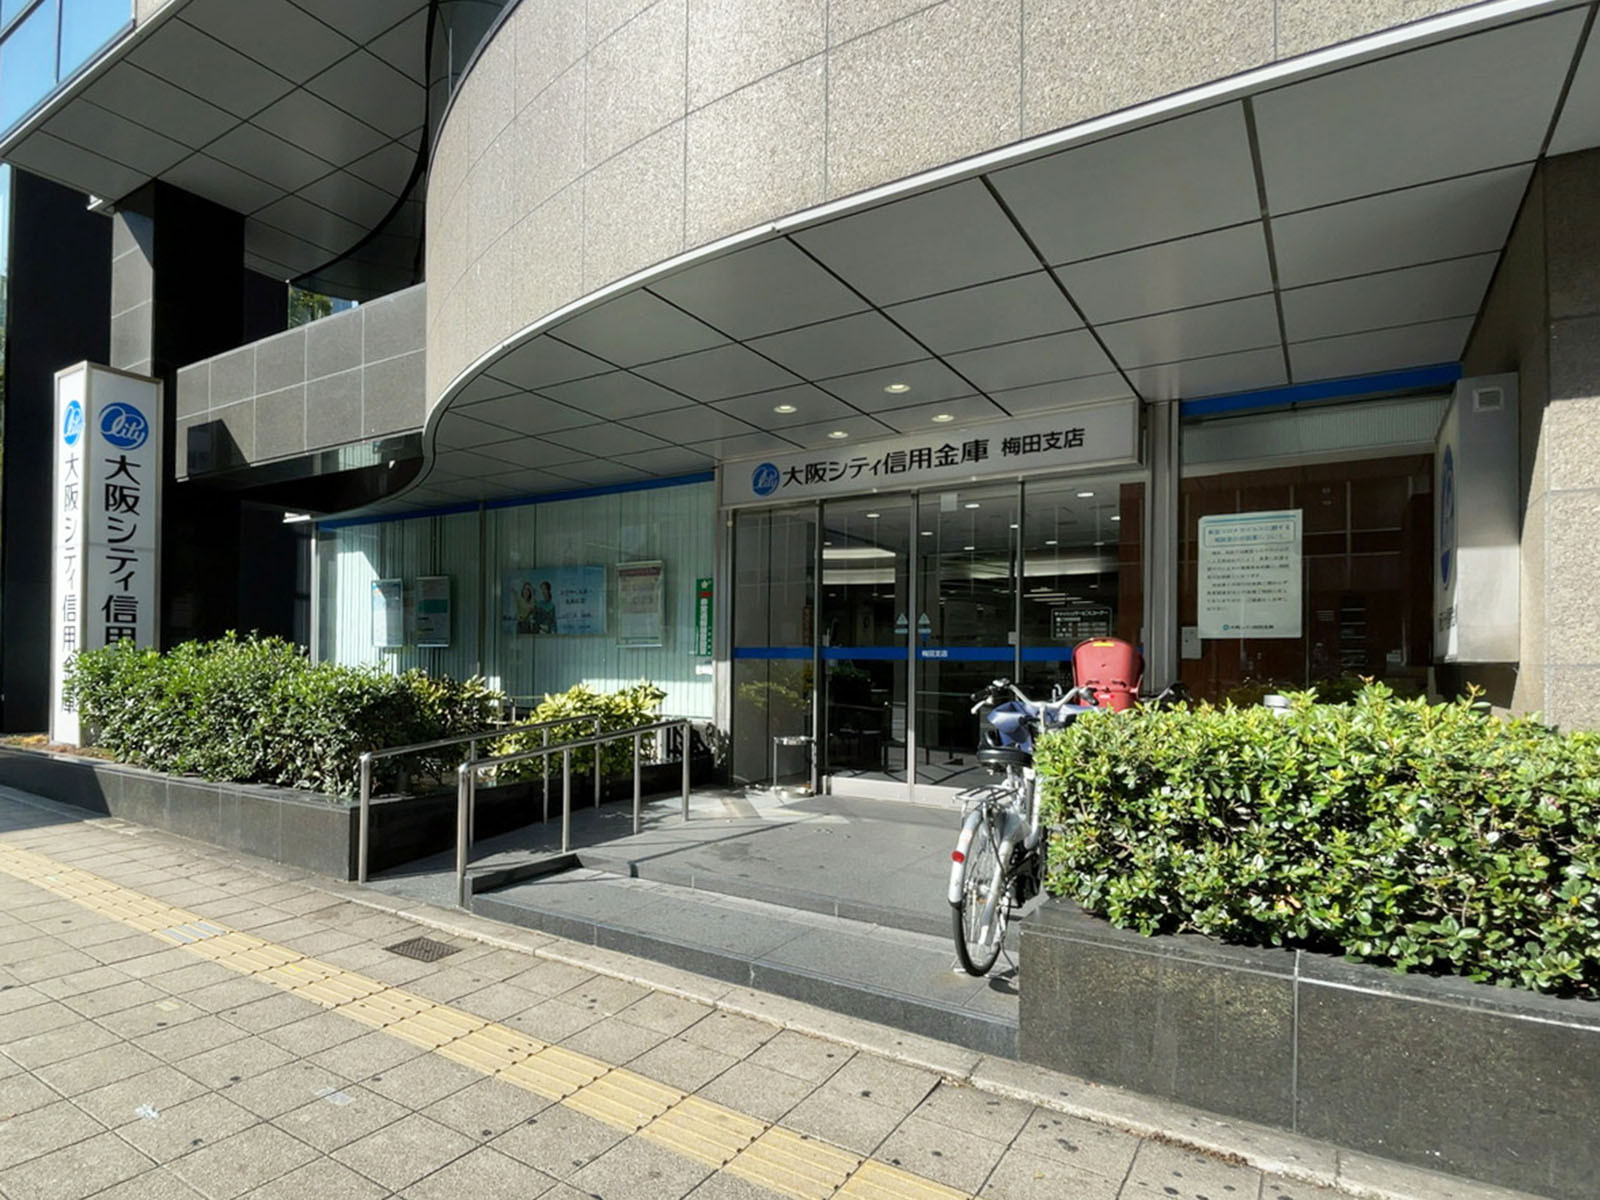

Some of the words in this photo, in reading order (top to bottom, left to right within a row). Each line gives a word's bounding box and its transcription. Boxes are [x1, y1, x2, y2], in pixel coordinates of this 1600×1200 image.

[782, 439, 989, 487] 大阪シティ信用金庫
[1001, 428, 1085, 457] 梅田支店
